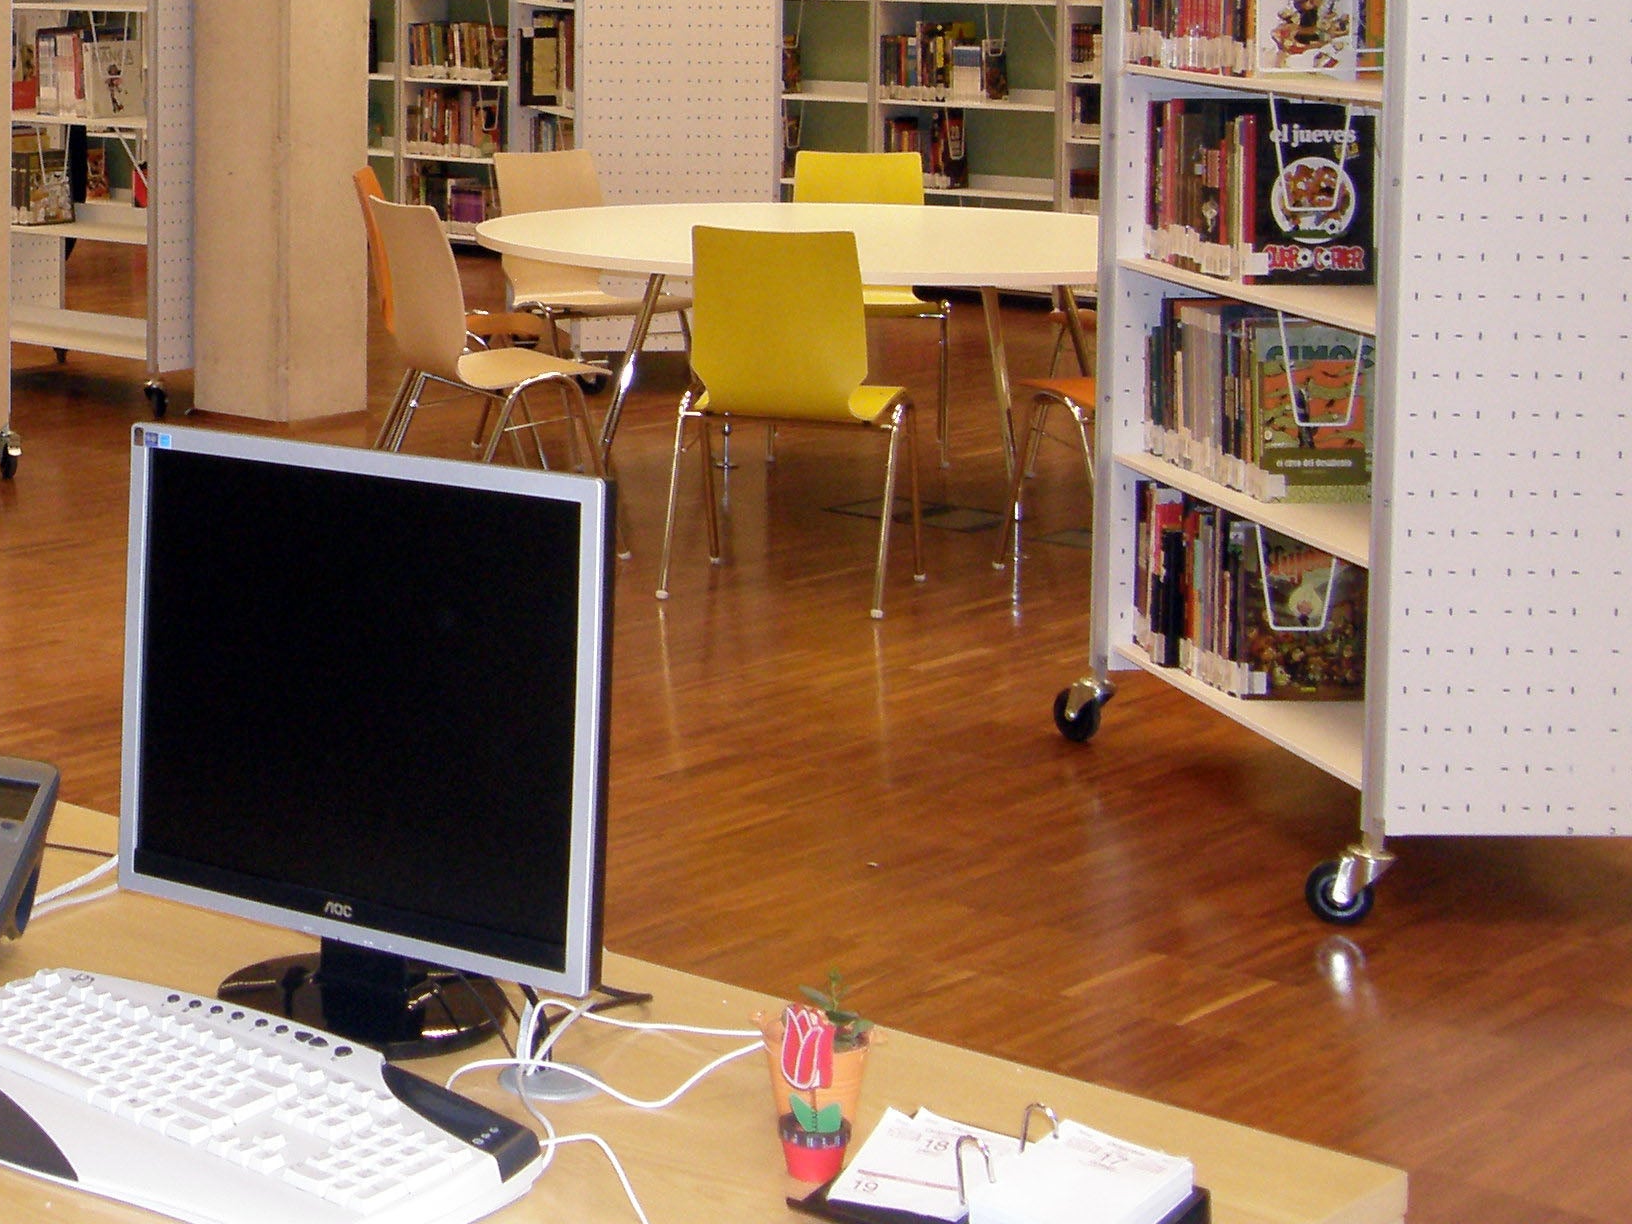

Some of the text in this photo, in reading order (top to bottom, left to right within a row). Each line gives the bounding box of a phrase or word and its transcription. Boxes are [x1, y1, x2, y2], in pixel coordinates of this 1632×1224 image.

[1269, 123, 1357, 148] el jueves
[324, 901, 353, 918] AOC
[925, 1139, 950, 1152] 18
[854, 1180, 879, 1194] 19
